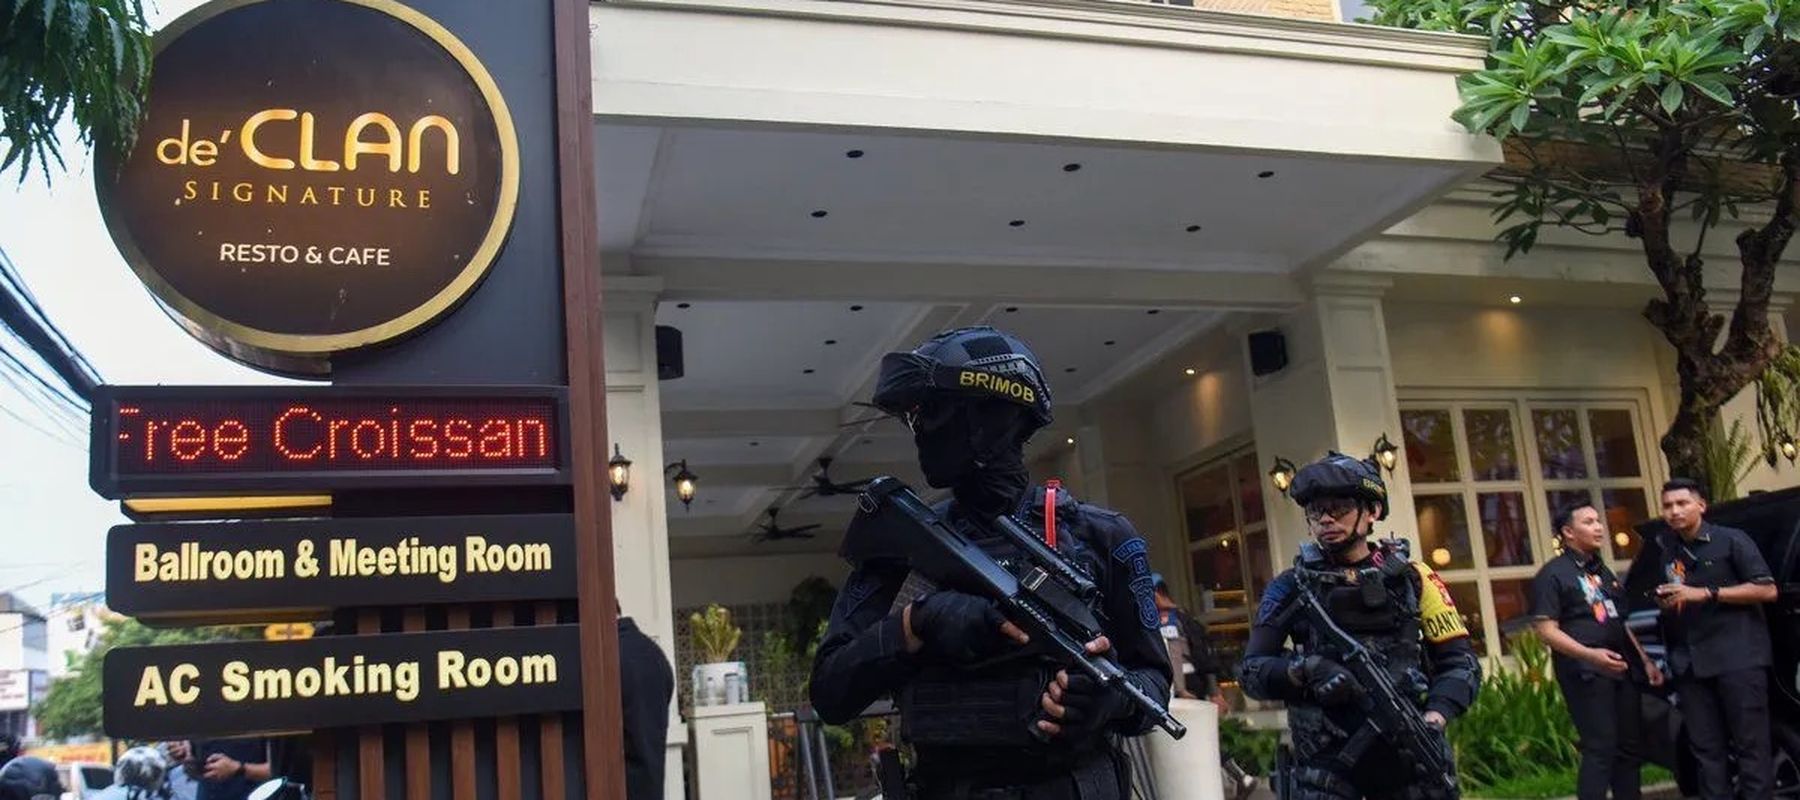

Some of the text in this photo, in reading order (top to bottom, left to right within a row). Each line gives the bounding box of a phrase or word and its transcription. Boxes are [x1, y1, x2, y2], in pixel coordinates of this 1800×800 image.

[183, 179, 431, 209] SIGNATURE
[219, 242, 391, 266] RESTO & CAFE
[959, 370, 1035, 404] BRIMOB
[274, 407, 546, 460] Croissan
[134, 535, 552, 584] Ballroom & Meeting Room
[134, 650, 557, 707] AC Smoking Room
